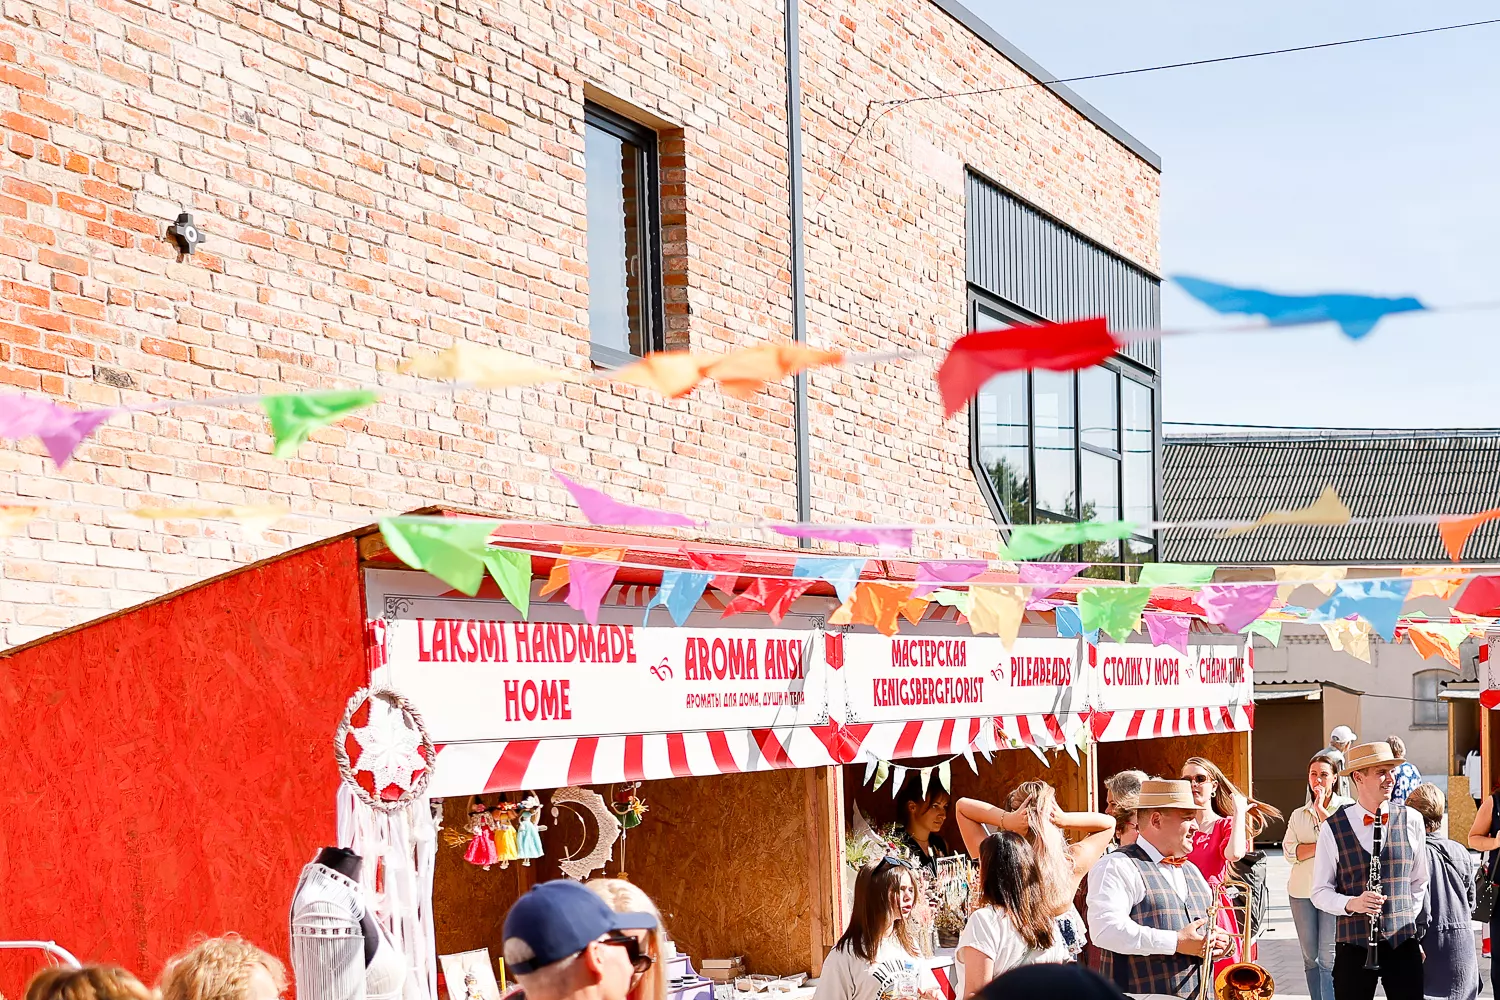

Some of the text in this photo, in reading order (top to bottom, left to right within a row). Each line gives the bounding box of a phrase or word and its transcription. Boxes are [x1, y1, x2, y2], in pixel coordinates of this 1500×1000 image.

[418, 618, 637, 663] LAKSMI HANDMADE
[892, 639, 967, 667] МАСТЕРСКАЯ
[685, 637, 804, 681] AROMA ANSI
[1011, 657, 1071, 687] PILEABEADS
[1103, 657, 1179, 686] СТОЛИК У МОРЯ
[503, 679, 572, 722] HOME
[686, 692, 721, 708] АРОМАТЫ
[724, 692, 737, 707] ДЛЯ
[873, 677, 984, 707] KENIGSBERGFLORIST
